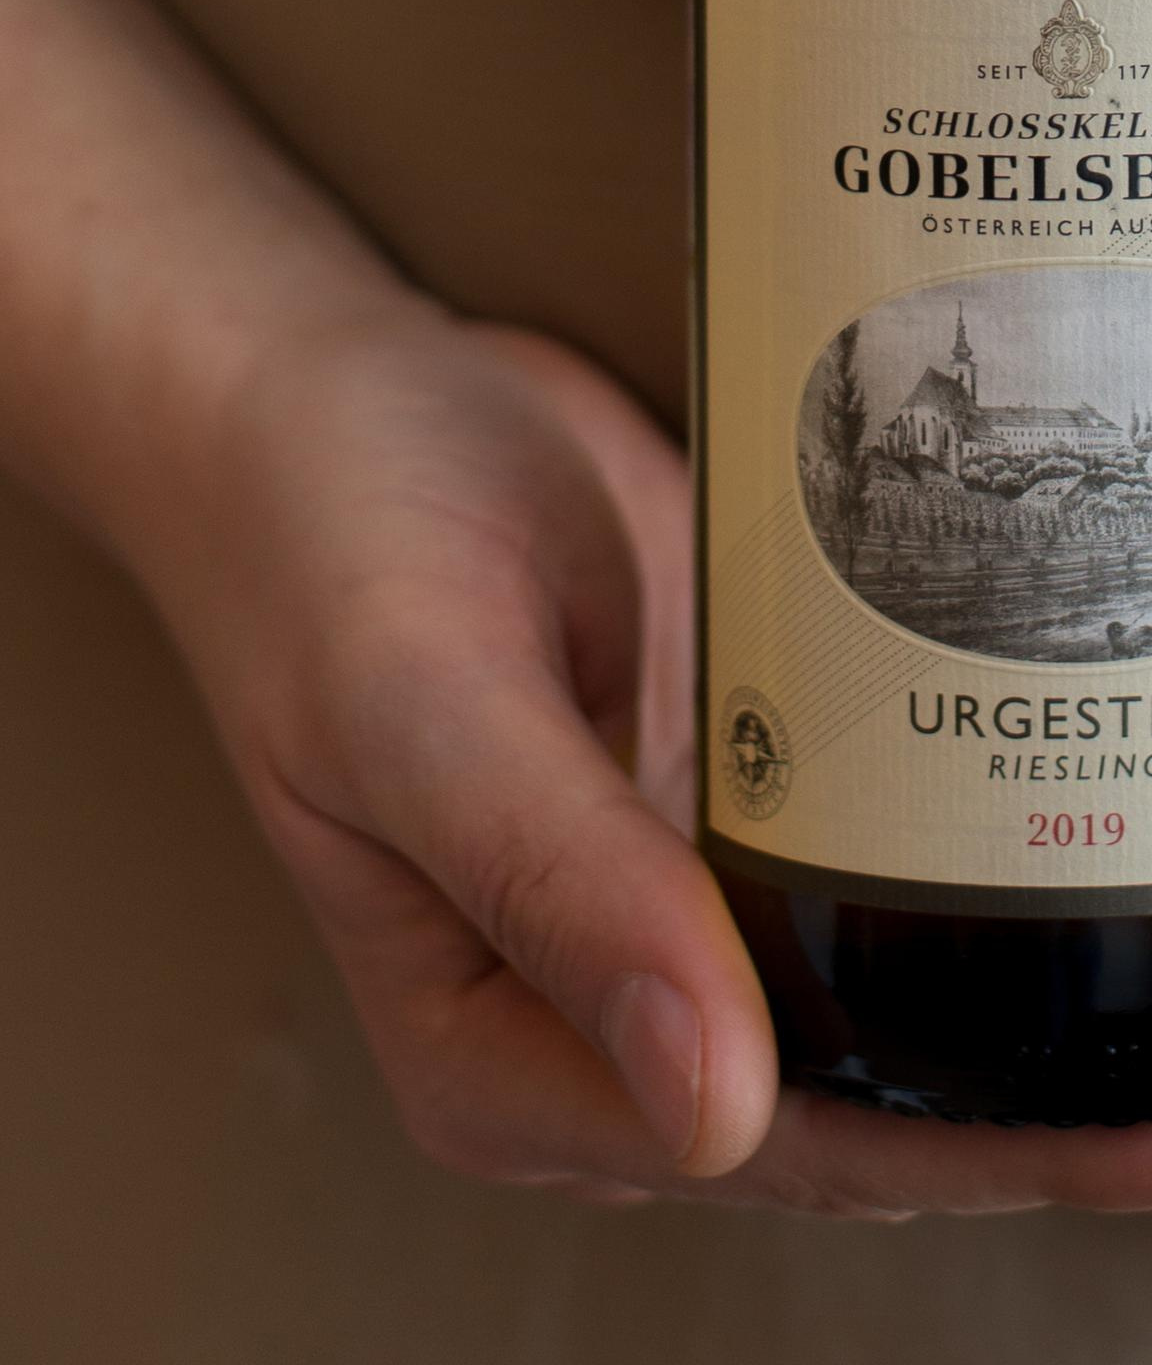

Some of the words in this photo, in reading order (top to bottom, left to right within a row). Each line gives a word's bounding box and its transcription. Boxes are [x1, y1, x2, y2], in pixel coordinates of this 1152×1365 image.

[977, 64, 1028, 80] SEIT
[921, 212, 1094, 238] ÖSTERREICH
[1027, 812, 1126, 847] 2019
